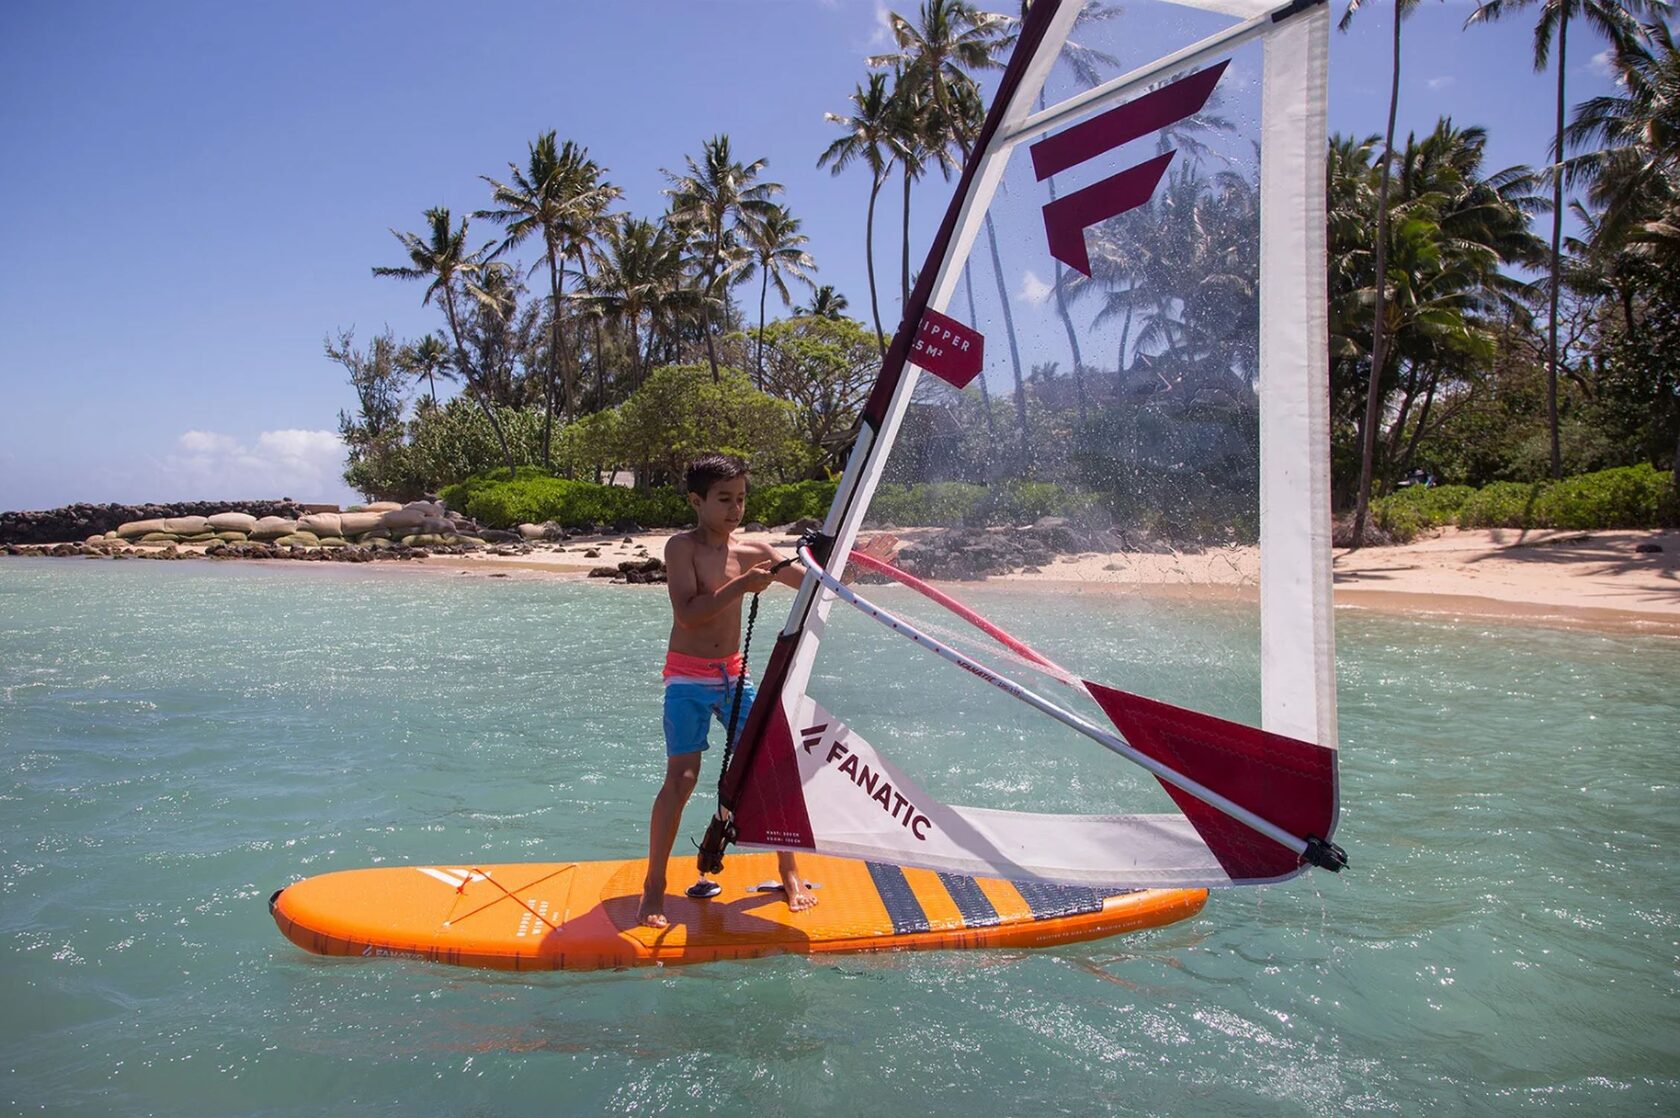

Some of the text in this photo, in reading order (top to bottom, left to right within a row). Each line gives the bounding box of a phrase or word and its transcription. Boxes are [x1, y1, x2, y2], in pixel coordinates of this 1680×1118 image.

[912, 339, 925, 351] .5
[919, 318, 970, 352] IPPER
[826, 740, 932, 841] FANATIC
